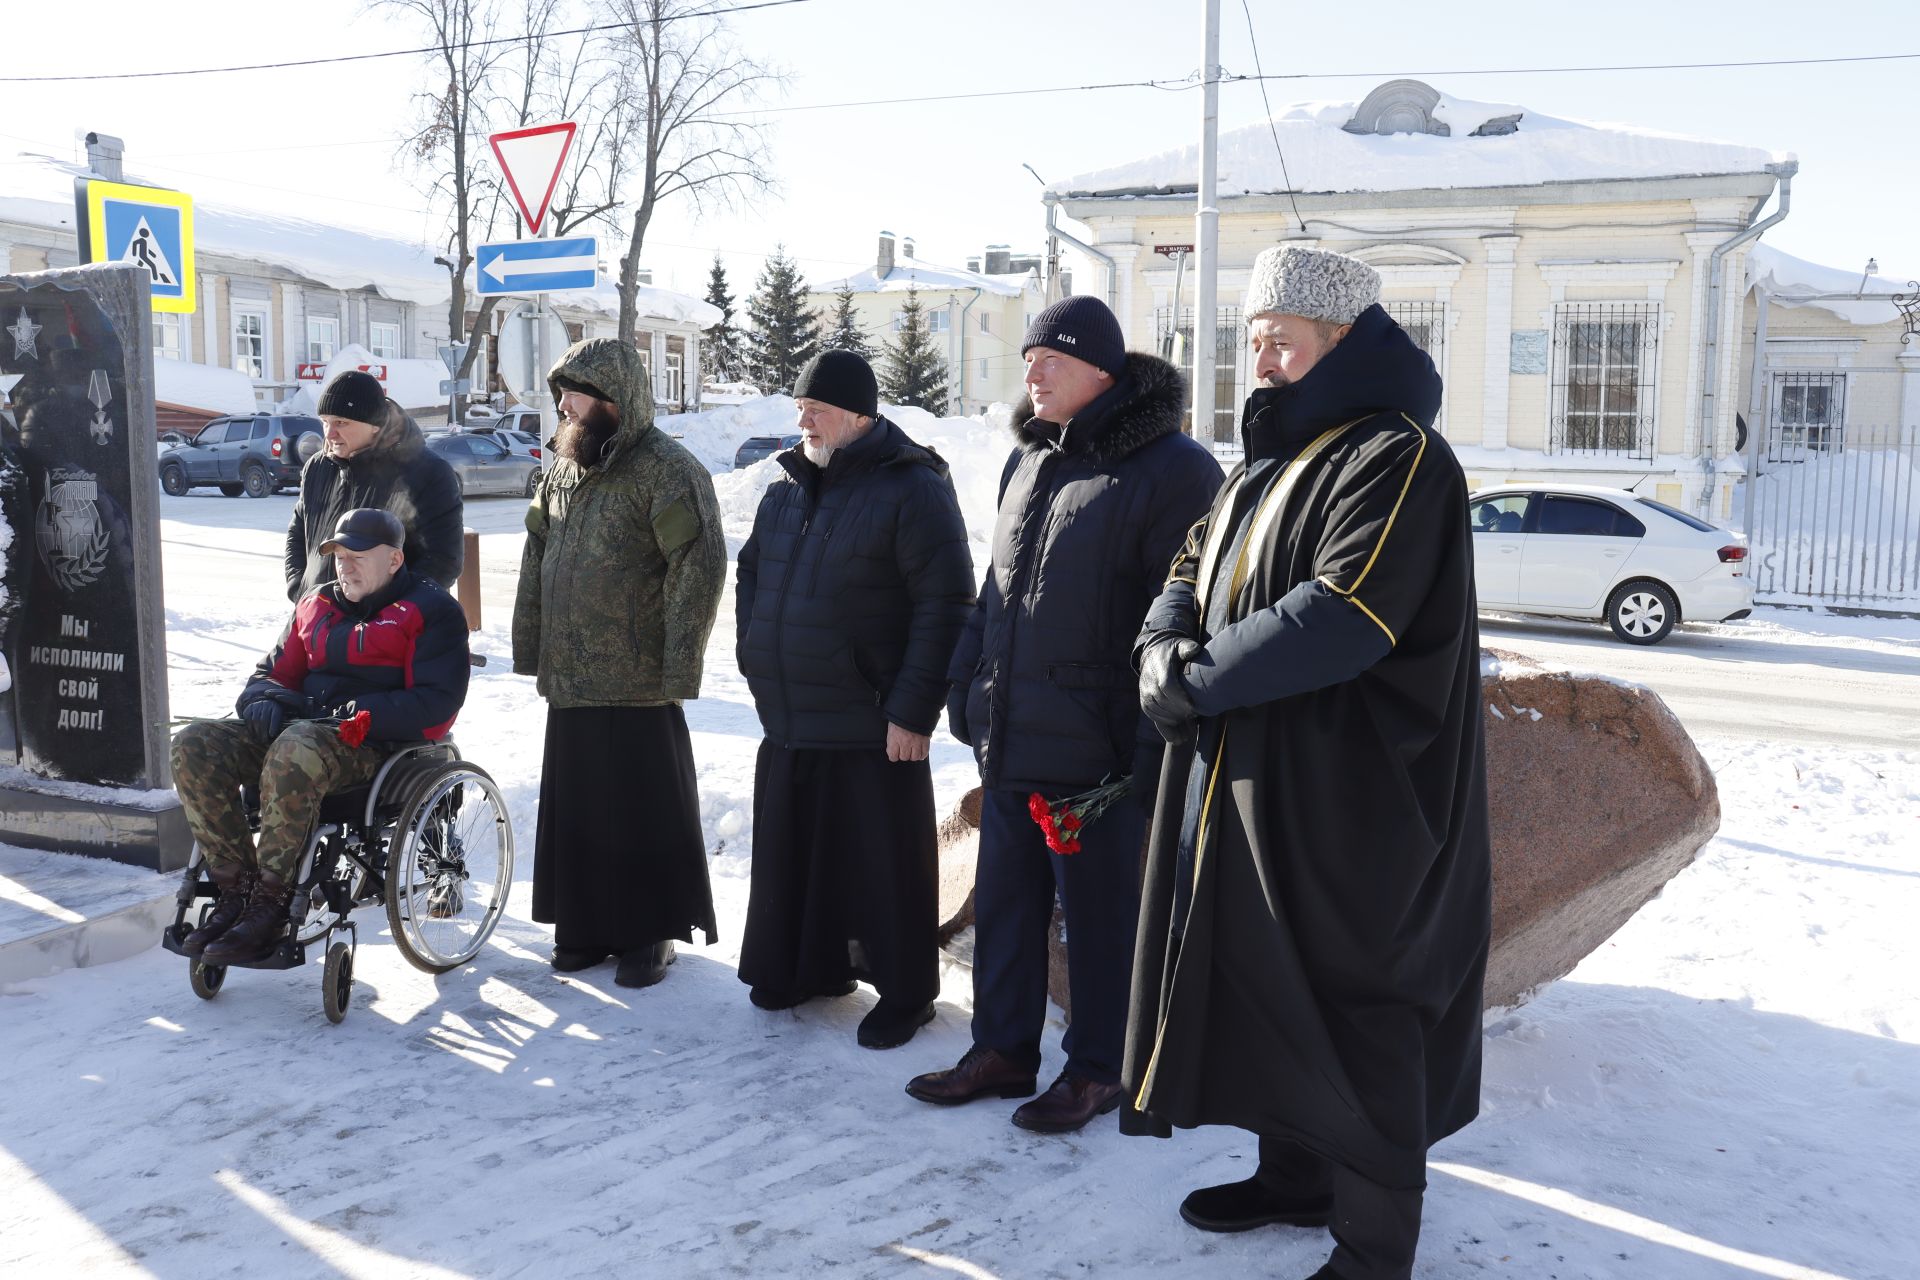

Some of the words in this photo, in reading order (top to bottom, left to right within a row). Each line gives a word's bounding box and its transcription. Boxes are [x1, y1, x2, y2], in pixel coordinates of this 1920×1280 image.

[1057, 333, 1076, 345] ALGA
[51, 467, 97, 480] Боевое
[61, 614, 89, 639] Мы
[30, 646, 125, 673] исполнили
[58, 677, 99, 701] свой
[57, 709, 104, 731] долг!
